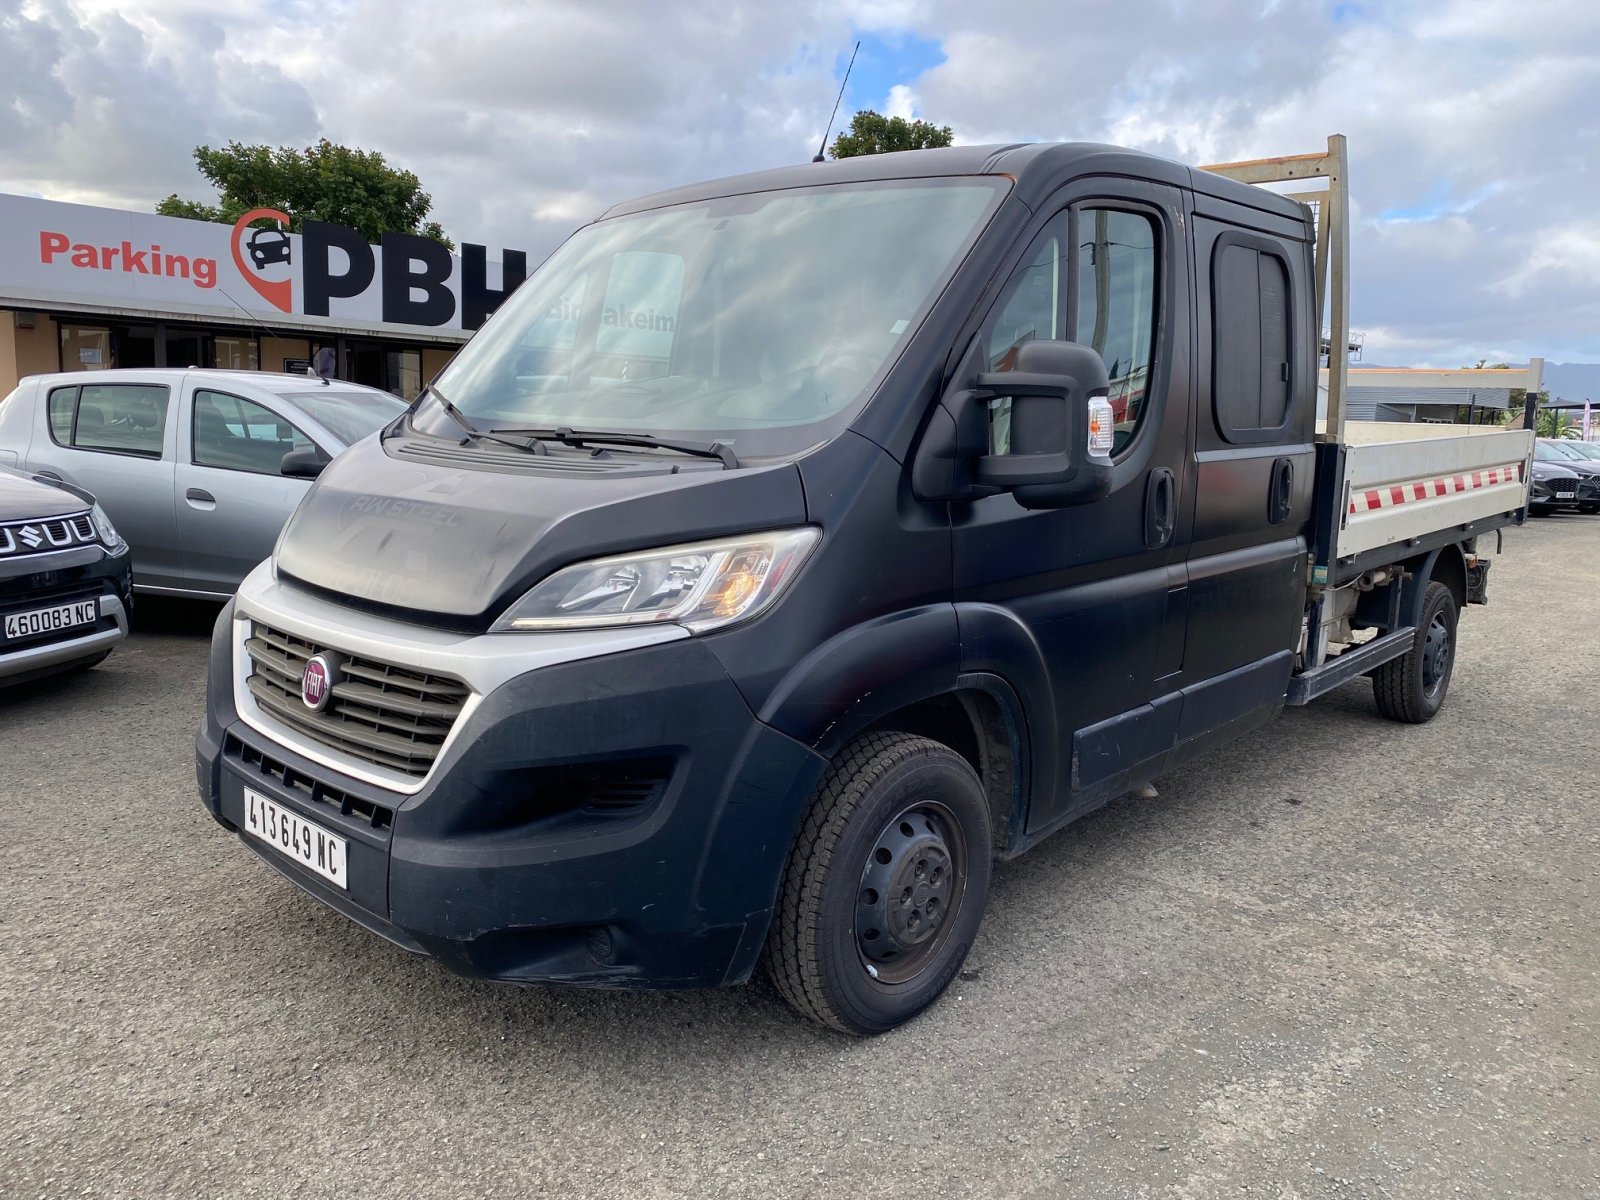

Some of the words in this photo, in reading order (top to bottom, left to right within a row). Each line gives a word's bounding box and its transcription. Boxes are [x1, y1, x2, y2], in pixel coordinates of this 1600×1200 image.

[40, 231, 217, 289] Parking
[302, 220, 527, 331] PBH
[600, 304, 675, 333] akeim
[7, 607, 72, 637] 460083
[75, 603, 95, 623] NC
[306, 670, 324, 698] FIAT
[249, 795, 311, 860] 413649
[317, 834, 337, 876] NC
